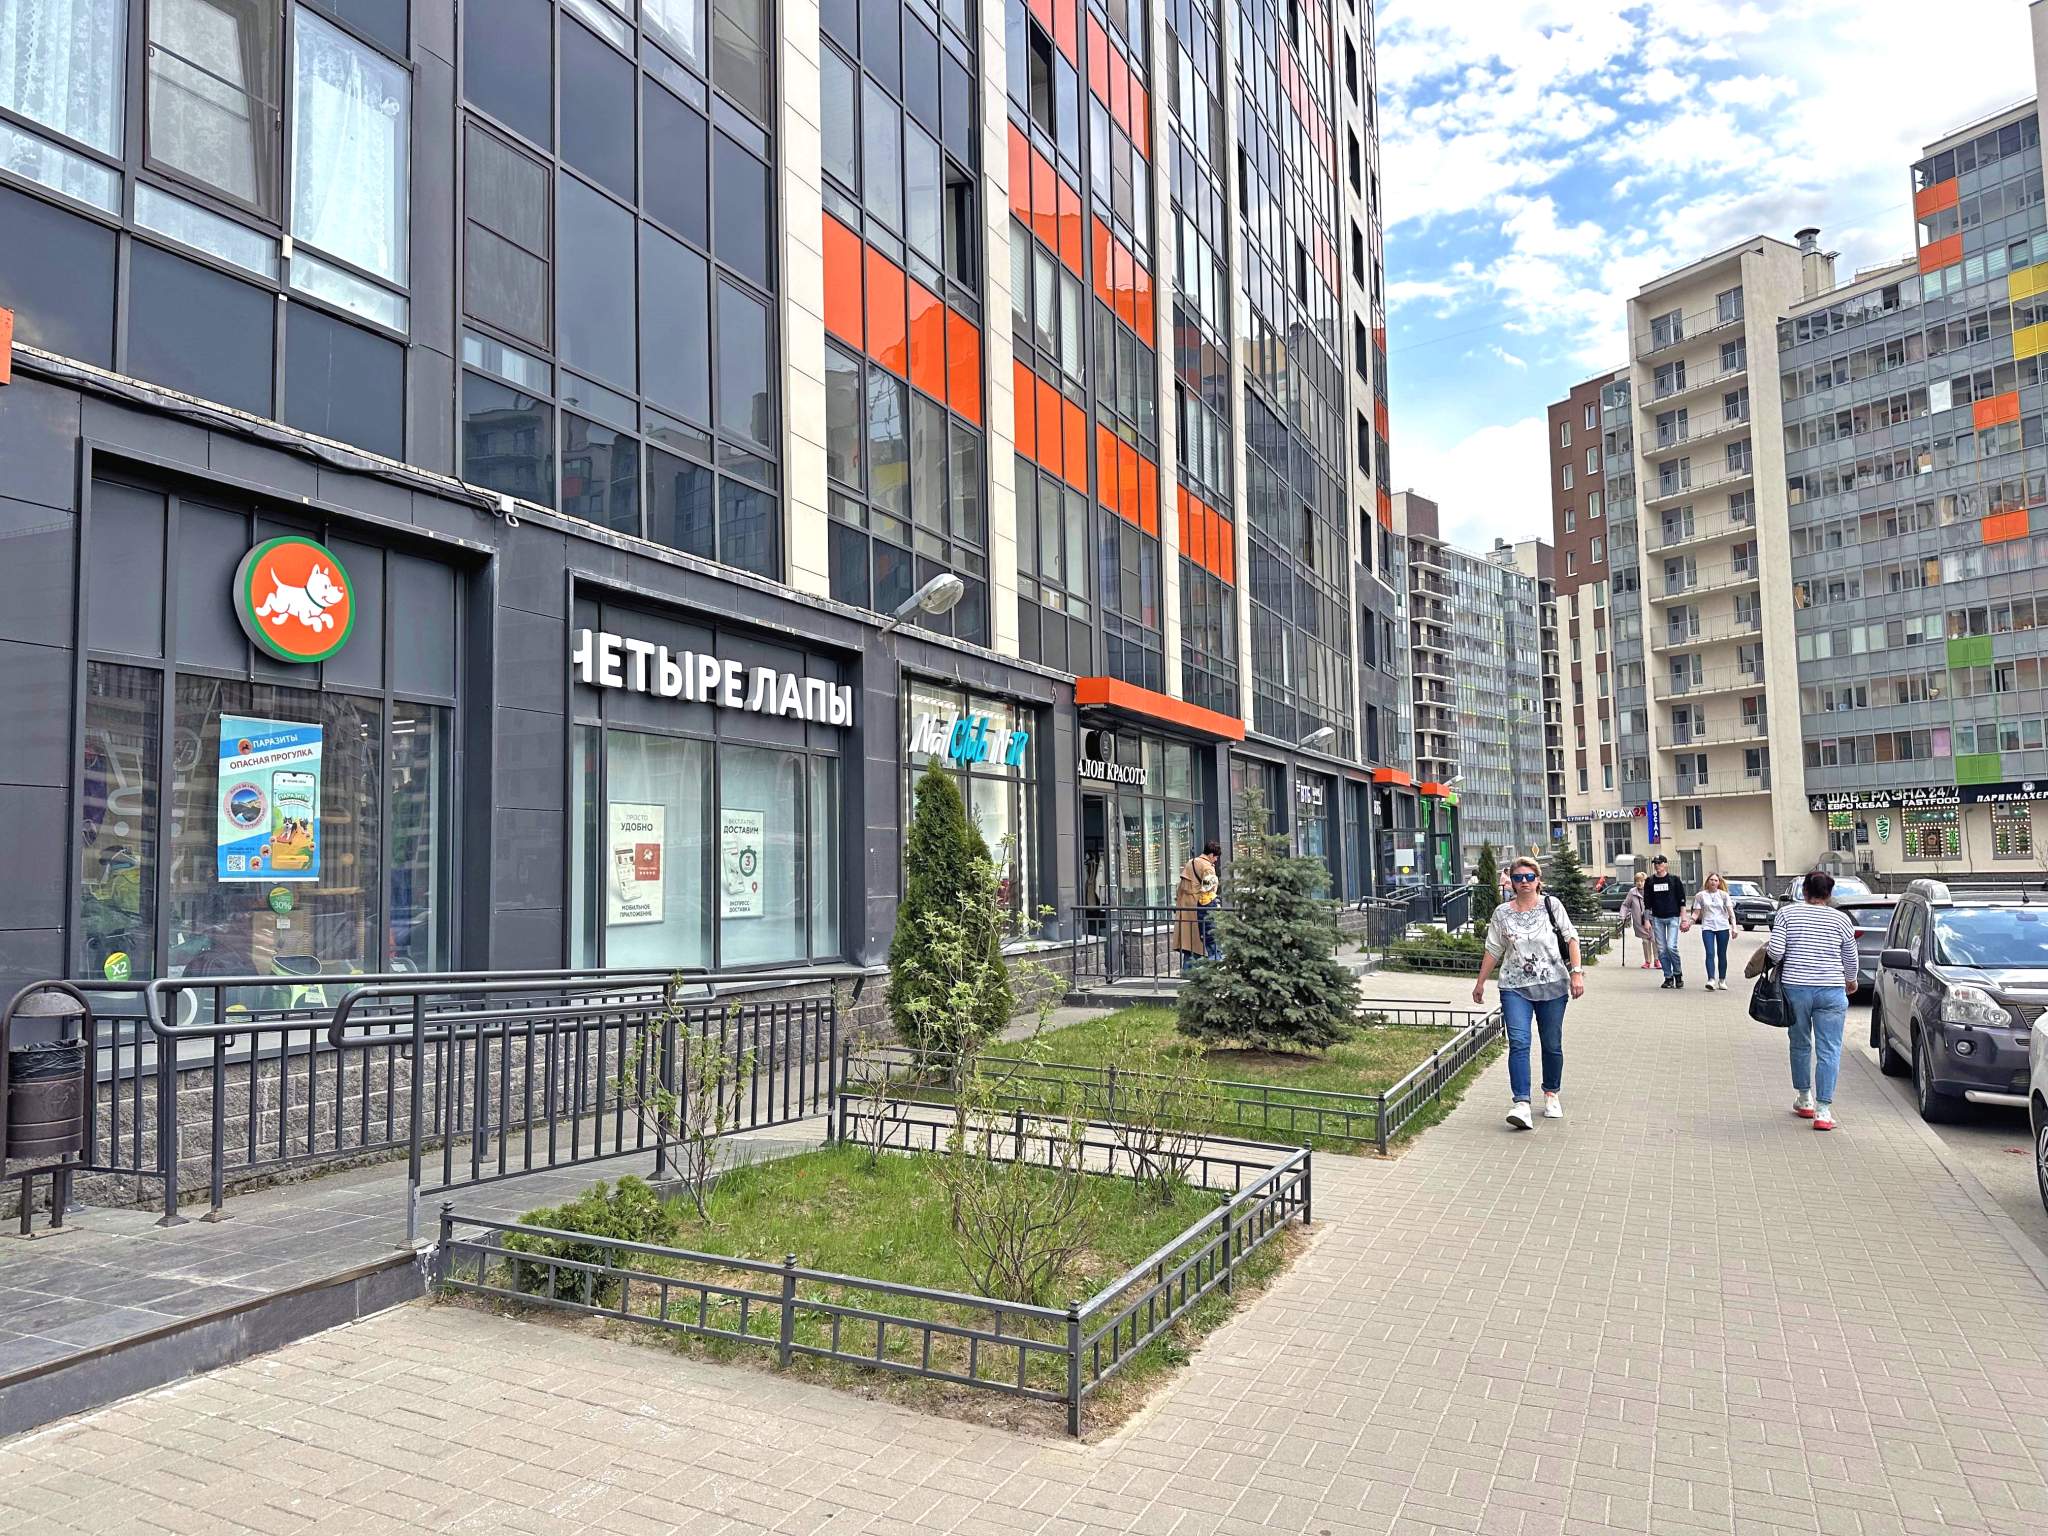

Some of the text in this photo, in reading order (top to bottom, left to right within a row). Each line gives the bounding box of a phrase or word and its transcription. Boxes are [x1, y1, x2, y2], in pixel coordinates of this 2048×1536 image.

[744, 667, 853, 727] ЛАПЫ
[252, 734, 298, 748] ПАРАЗИТЫ
[908, 711, 959, 766] Nail
[949, 714, 991, 768] Club
[230, 748, 313, 770] ОПАСНАЯ ПРОГУЛКА
[1107, 763, 1148, 785] КРАСОТЫ
[1928, 785, 1960, 799] 24/7
[1827, 800, 1890, 811] ЕВРО КЕБАБ
[1902, 796, 1960, 807] FASTFOOD
[620, 822, 654, 832] УДОБНО
[723, 825, 759, 835] ДОСТАВИМ
[745, 855, 751, 867] 3
[621, 903, 650, 911] МОБИЛЬНОЕ
[620, 910, 652, 918] ПРИЛОЖЕНИЕ
